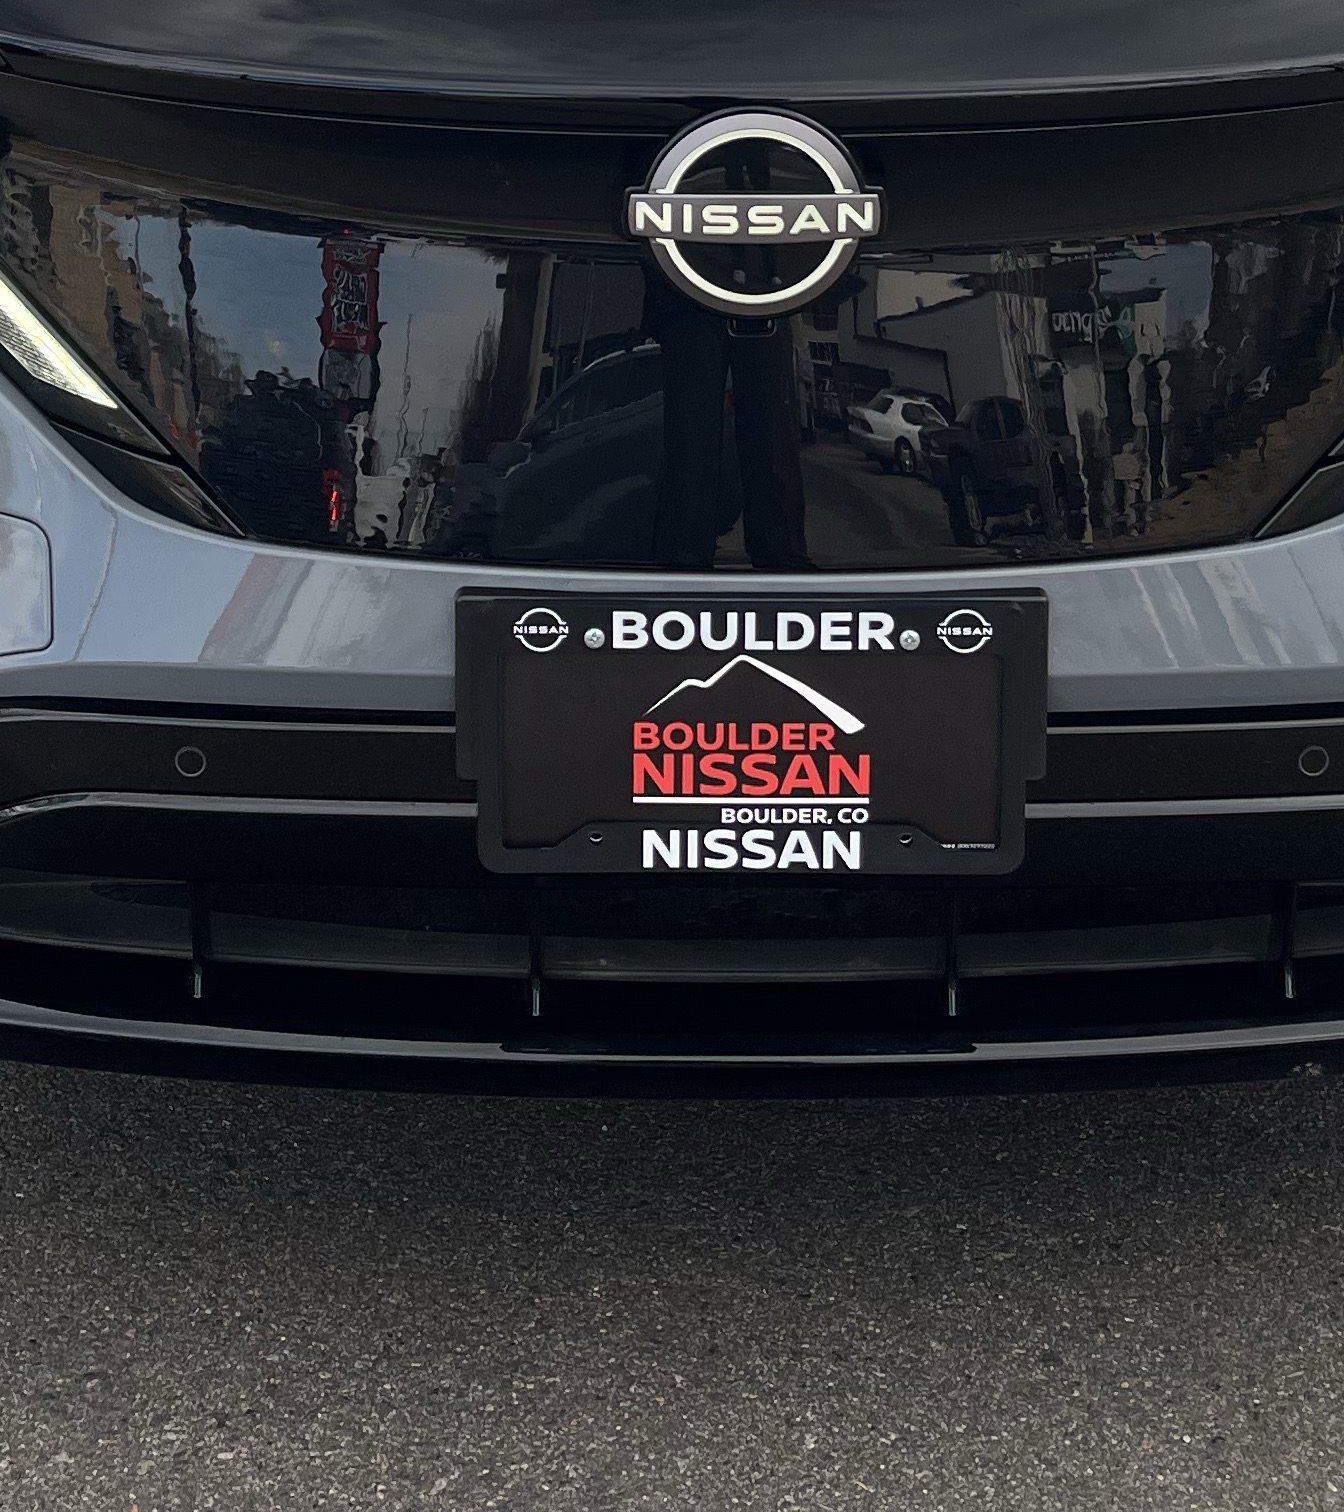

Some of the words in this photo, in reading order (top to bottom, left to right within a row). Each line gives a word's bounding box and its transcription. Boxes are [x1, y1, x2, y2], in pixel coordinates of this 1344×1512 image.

[635, 201, 874, 235] NISSAN
[513, 625, 569, 634] NISSAN
[612, 611, 895, 651] BOULDER
[936, 627, 993, 636] NISSAN
[633, 722, 835, 750] BOULDER
[633, 753, 871, 796] NISSAN
[721, 808, 833, 825] BOULDER,
[837, 808, 869, 824] CO
[642, 829, 861, 870] NISSAN
